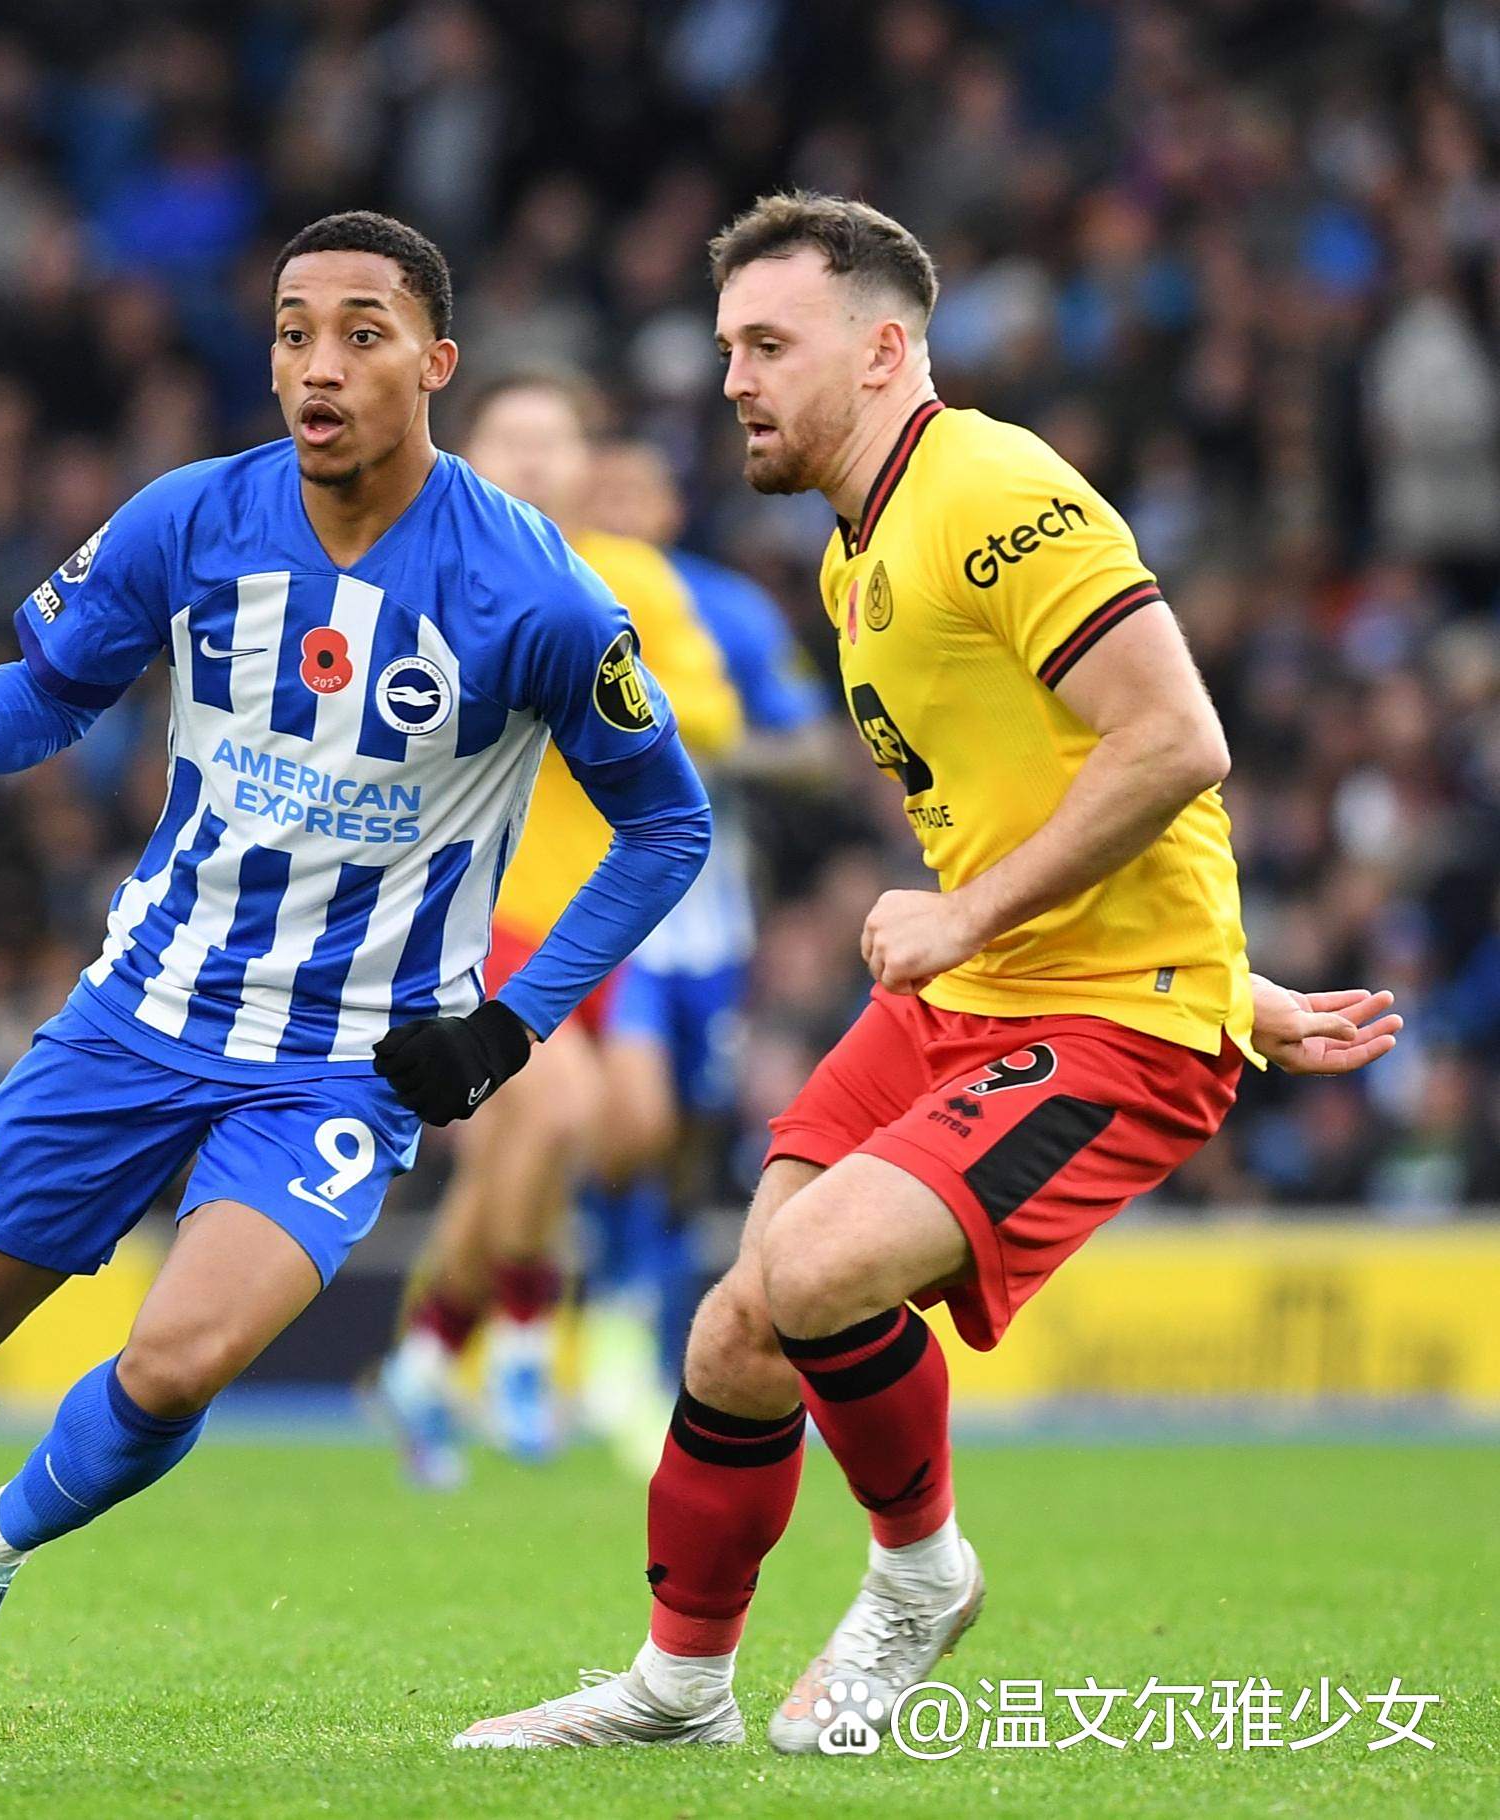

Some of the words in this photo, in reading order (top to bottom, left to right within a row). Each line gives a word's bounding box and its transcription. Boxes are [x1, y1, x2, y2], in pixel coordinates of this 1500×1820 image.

[964, 498, 1089, 589] Gtech
[312, 675, 342, 688] 2023
[395, 722, 425, 732] ALBION
[212, 738, 421, 812] AMERICAN
[234, 780, 420, 844] EXPRESS
[314, 1117, 376, 1201] 9
